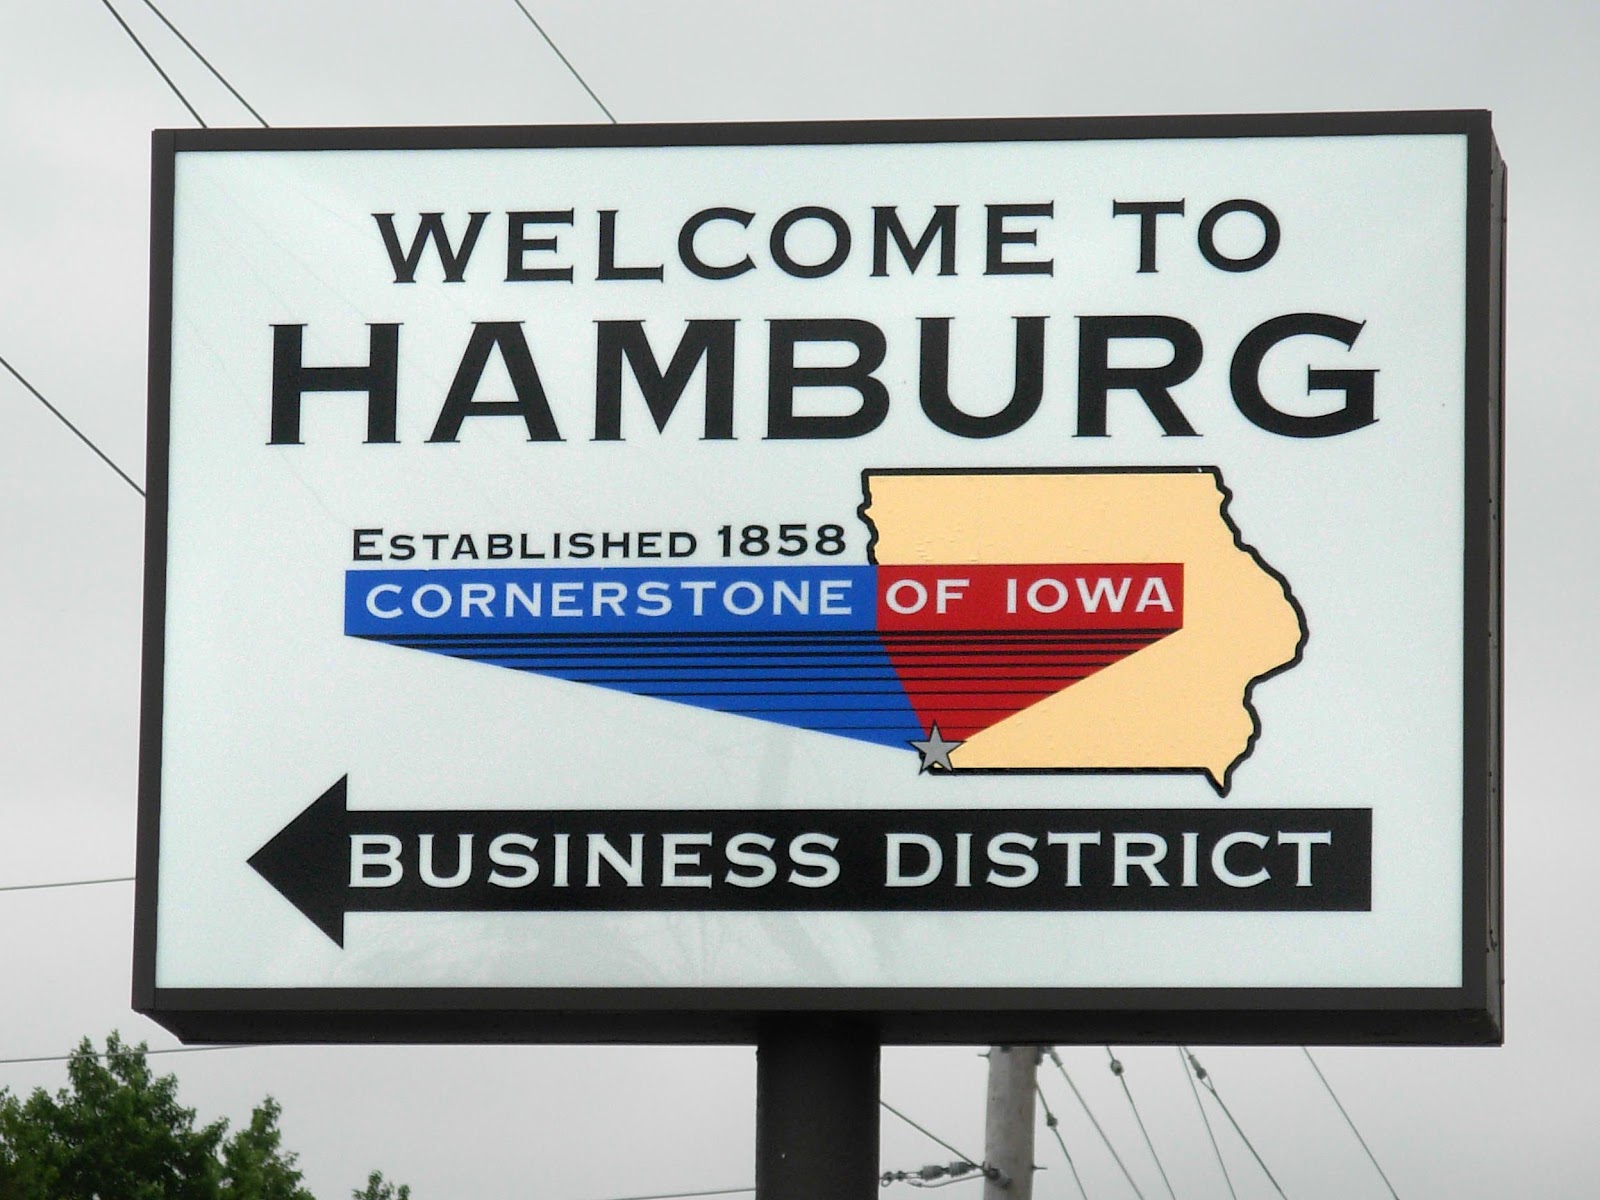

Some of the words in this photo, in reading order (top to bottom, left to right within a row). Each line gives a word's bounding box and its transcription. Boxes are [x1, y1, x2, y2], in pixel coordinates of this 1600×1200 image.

[371, 201, 1053, 283] WELCOME
[1113, 198, 1280, 273] TO
[266, 313, 1380, 445] HAMBURG
[353, 528, 696, 561] ESTABLISHED
[717, 524, 845, 557] 1858
[366, 579, 852, 619] CORNERSTONE
[886, 578, 970, 614] OF
[1007, 577, 1174, 614] IOWA
[349, 832, 840, 888] BUSINESS
[885, 831, 1332, 888] DISTRICT
